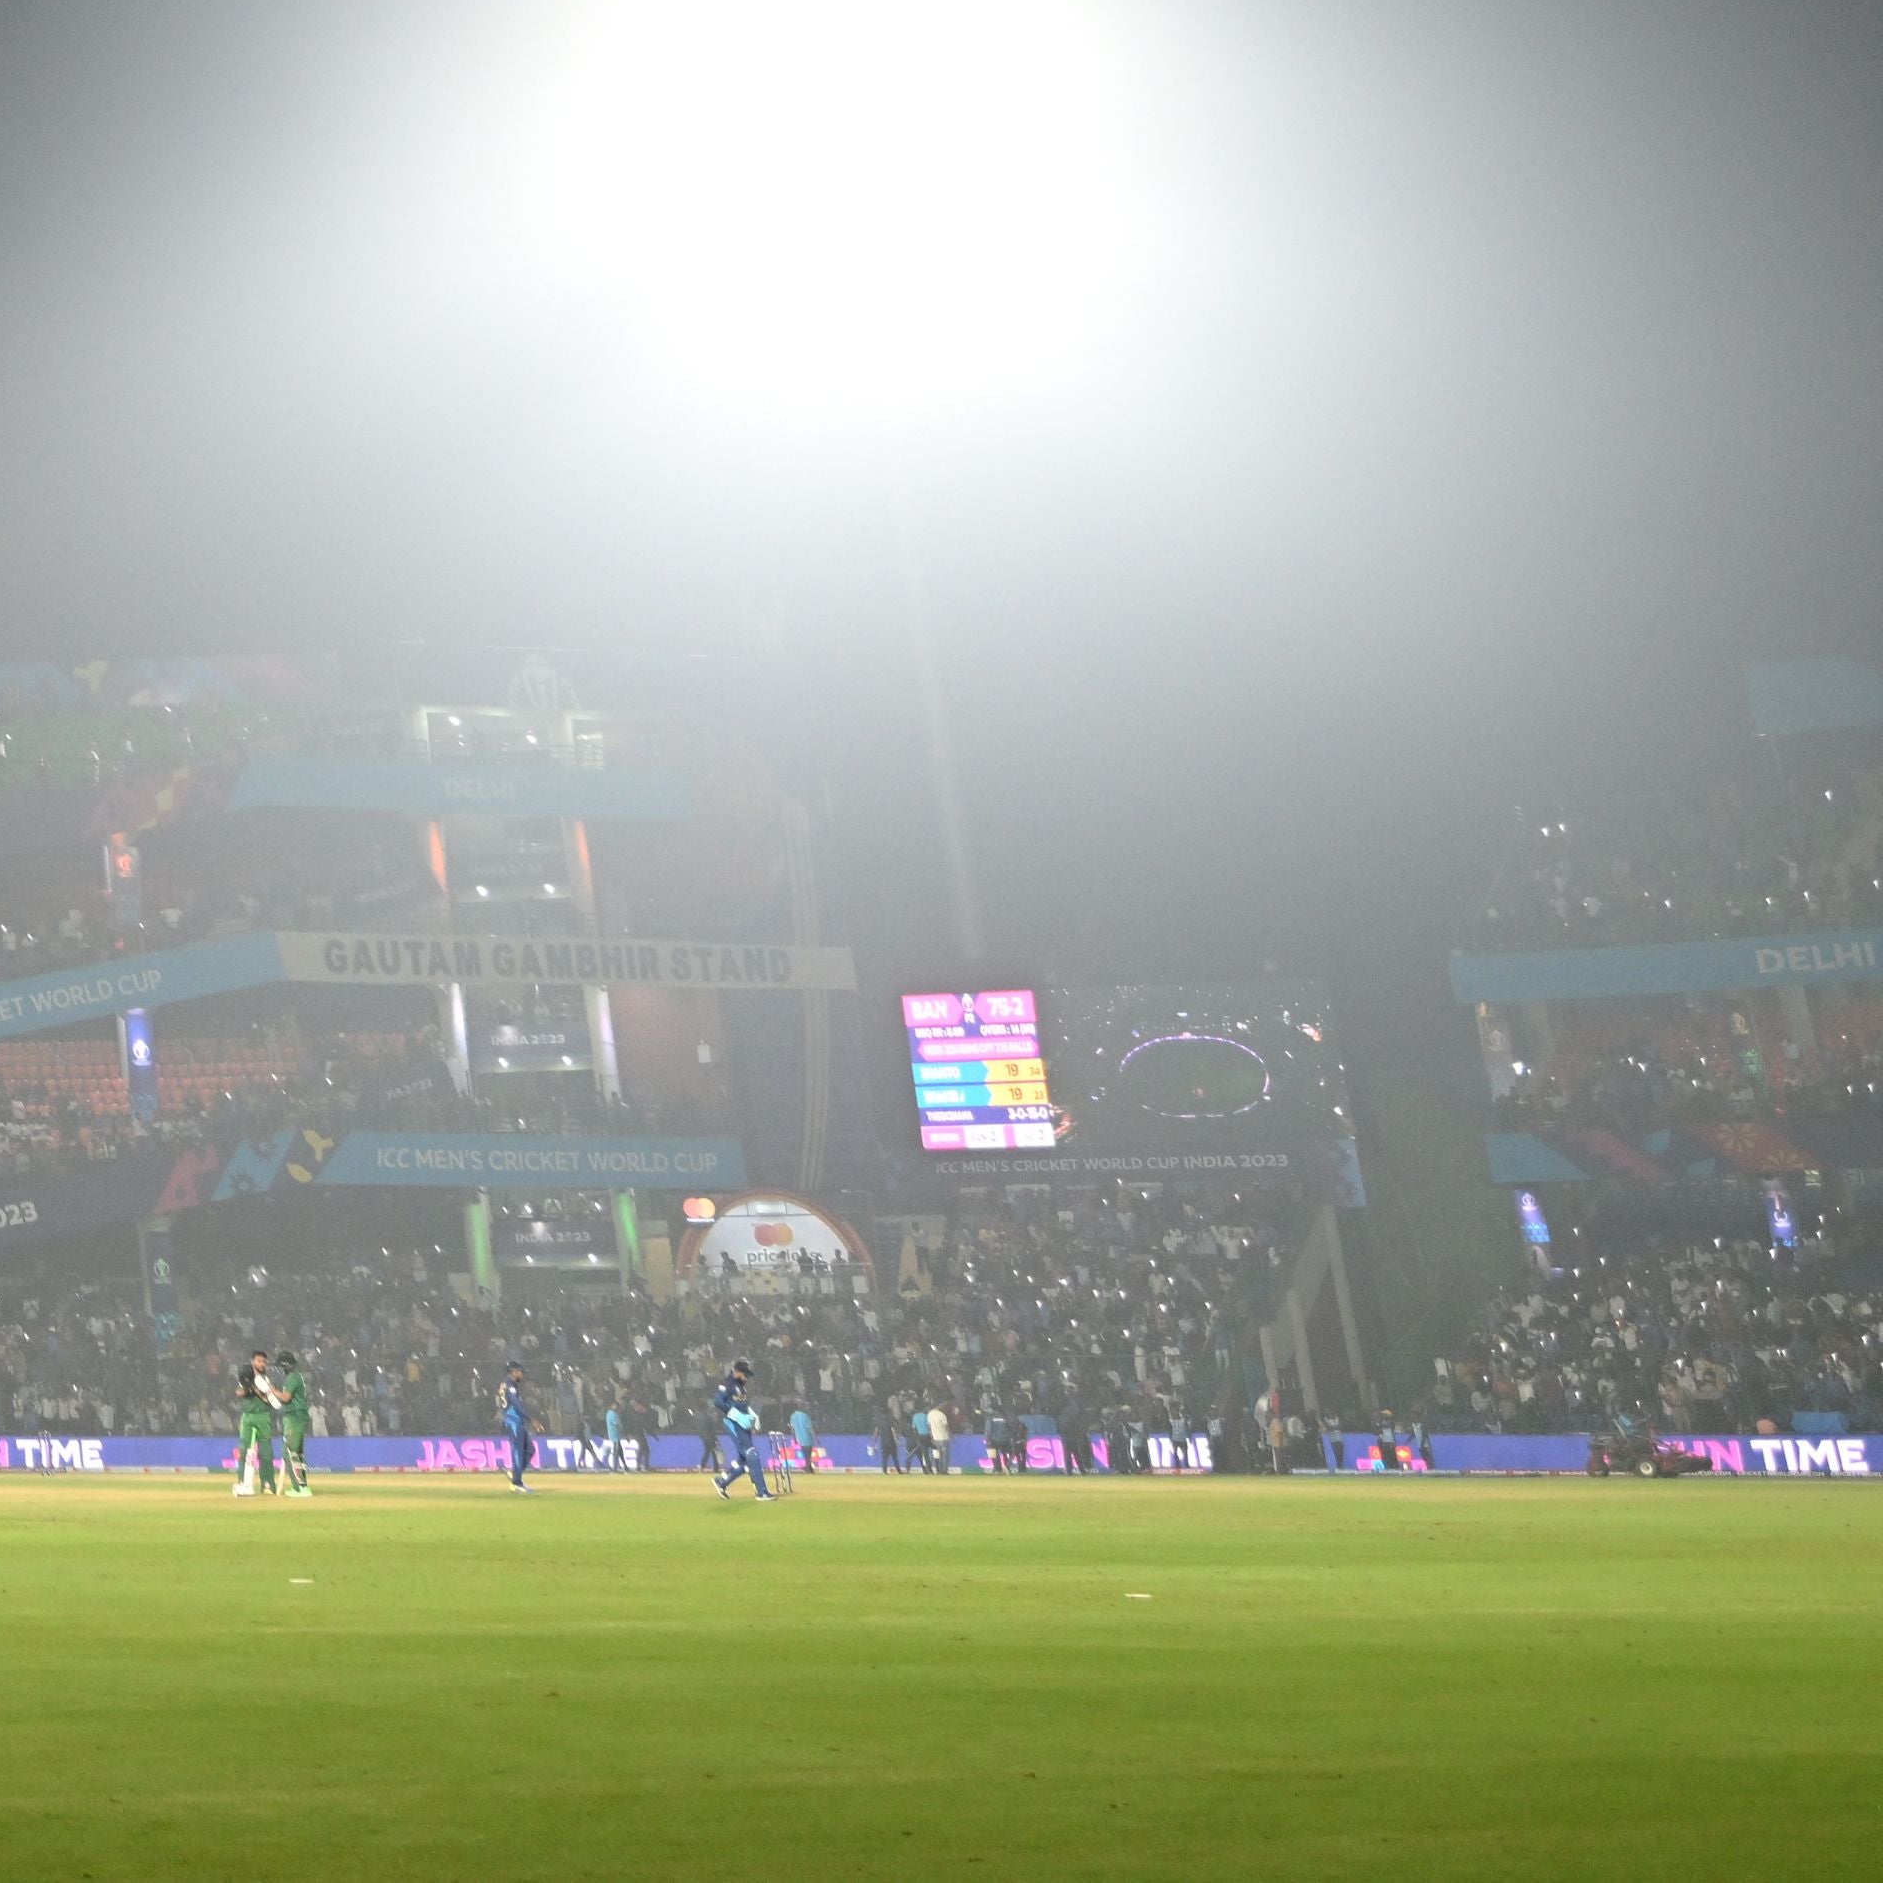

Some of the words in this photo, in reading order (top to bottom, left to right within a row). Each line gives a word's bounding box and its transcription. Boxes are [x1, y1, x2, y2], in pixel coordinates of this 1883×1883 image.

[441, 777, 516, 800] DELHI
[324, 939, 483, 977] GAUTAM
[491, 942, 661, 980] GAMBHIR
[670, 947, 793, 982] STAND
[1755, 941, 1876, 974] DELHI
[30, 980, 114, 1014] WORLD
[117, 969, 163, 995] CUP
[911, 1000, 948, 1021] BAN
[987, 996, 1024, 1017] 75-2
[1005, 1064, 1019, 1077] 19
[1009, 1087, 1022, 1100] 19
[377, 1147, 409, 1168] ICC
[414, 1148, 484, 1171] MEN'S
[487, 1149, 580, 1172] CRICKET
[587, 1151, 669, 1173] WORLD
[673, 1152, 718, 1174] CUP
[936, 1162, 958, 1174] ICC
[962, 1160, 1010, 1173] MEN'S
[1014, 1159, 1078, 1172] CRICKET
[1083, 1157, 1144, 1170] WORLD
[1147, 1156, 1179, 1169] CUP
[1184, 1155, 1235, 1168] INDIA
[1239, 1154, 1289, 1167] 2023
[15, 1439, 104, 1469] TIME
[1750, 1439, 1869, 1472] TIME
